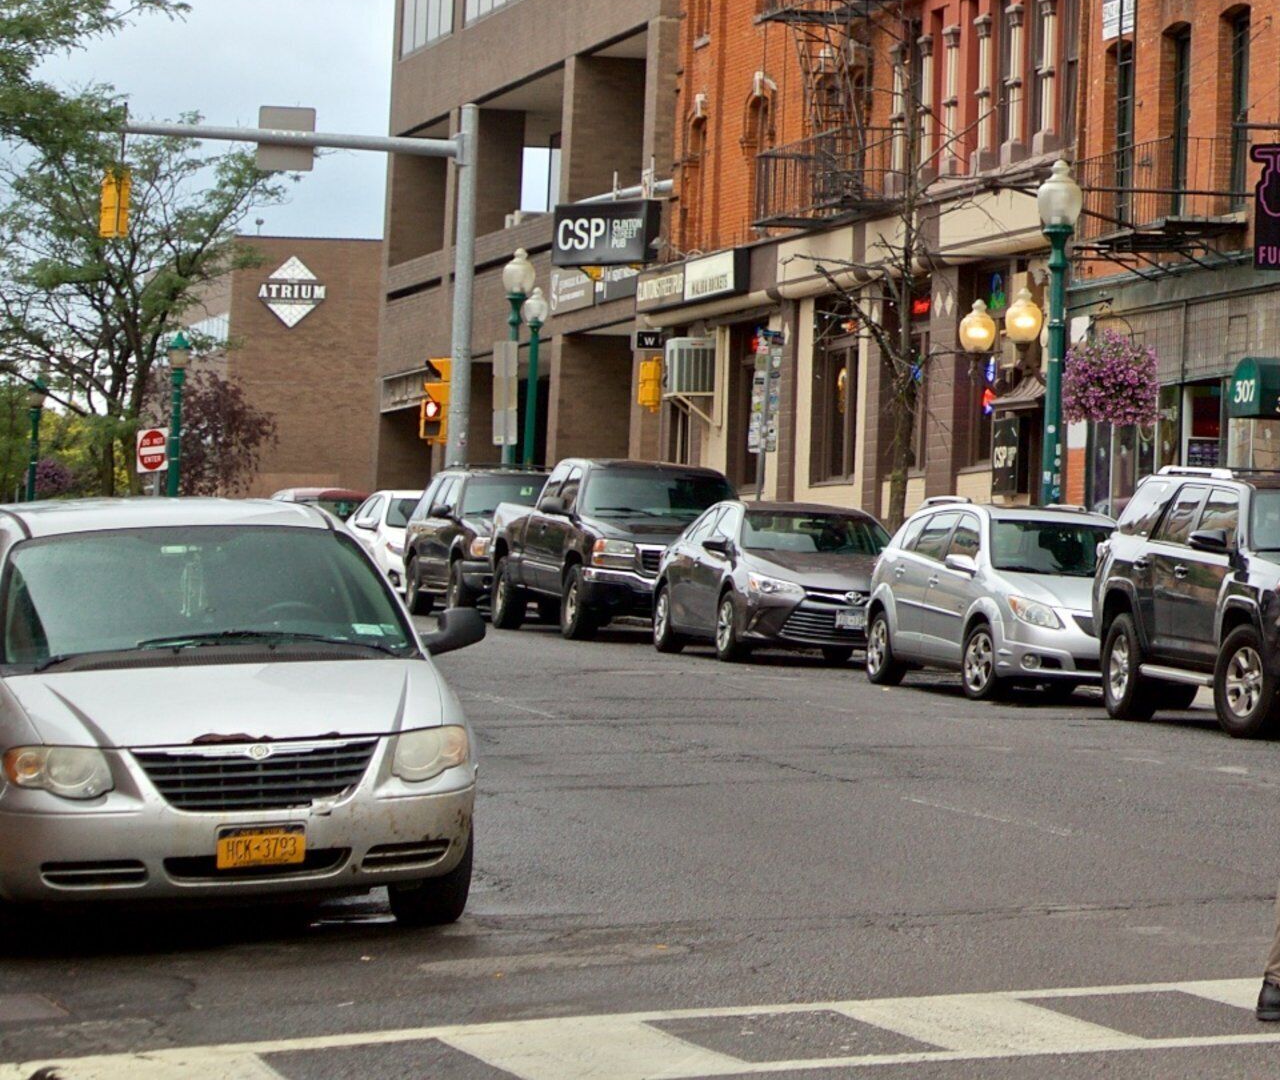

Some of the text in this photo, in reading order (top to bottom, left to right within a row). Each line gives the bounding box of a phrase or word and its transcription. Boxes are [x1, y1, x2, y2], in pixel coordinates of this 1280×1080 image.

[557, 218, 606, 251] CSP
[258, 283, 327, 300] ATRIUM
[1234, 379, 1256, 404] 307
[144, 455, 162, 464] ENTER
